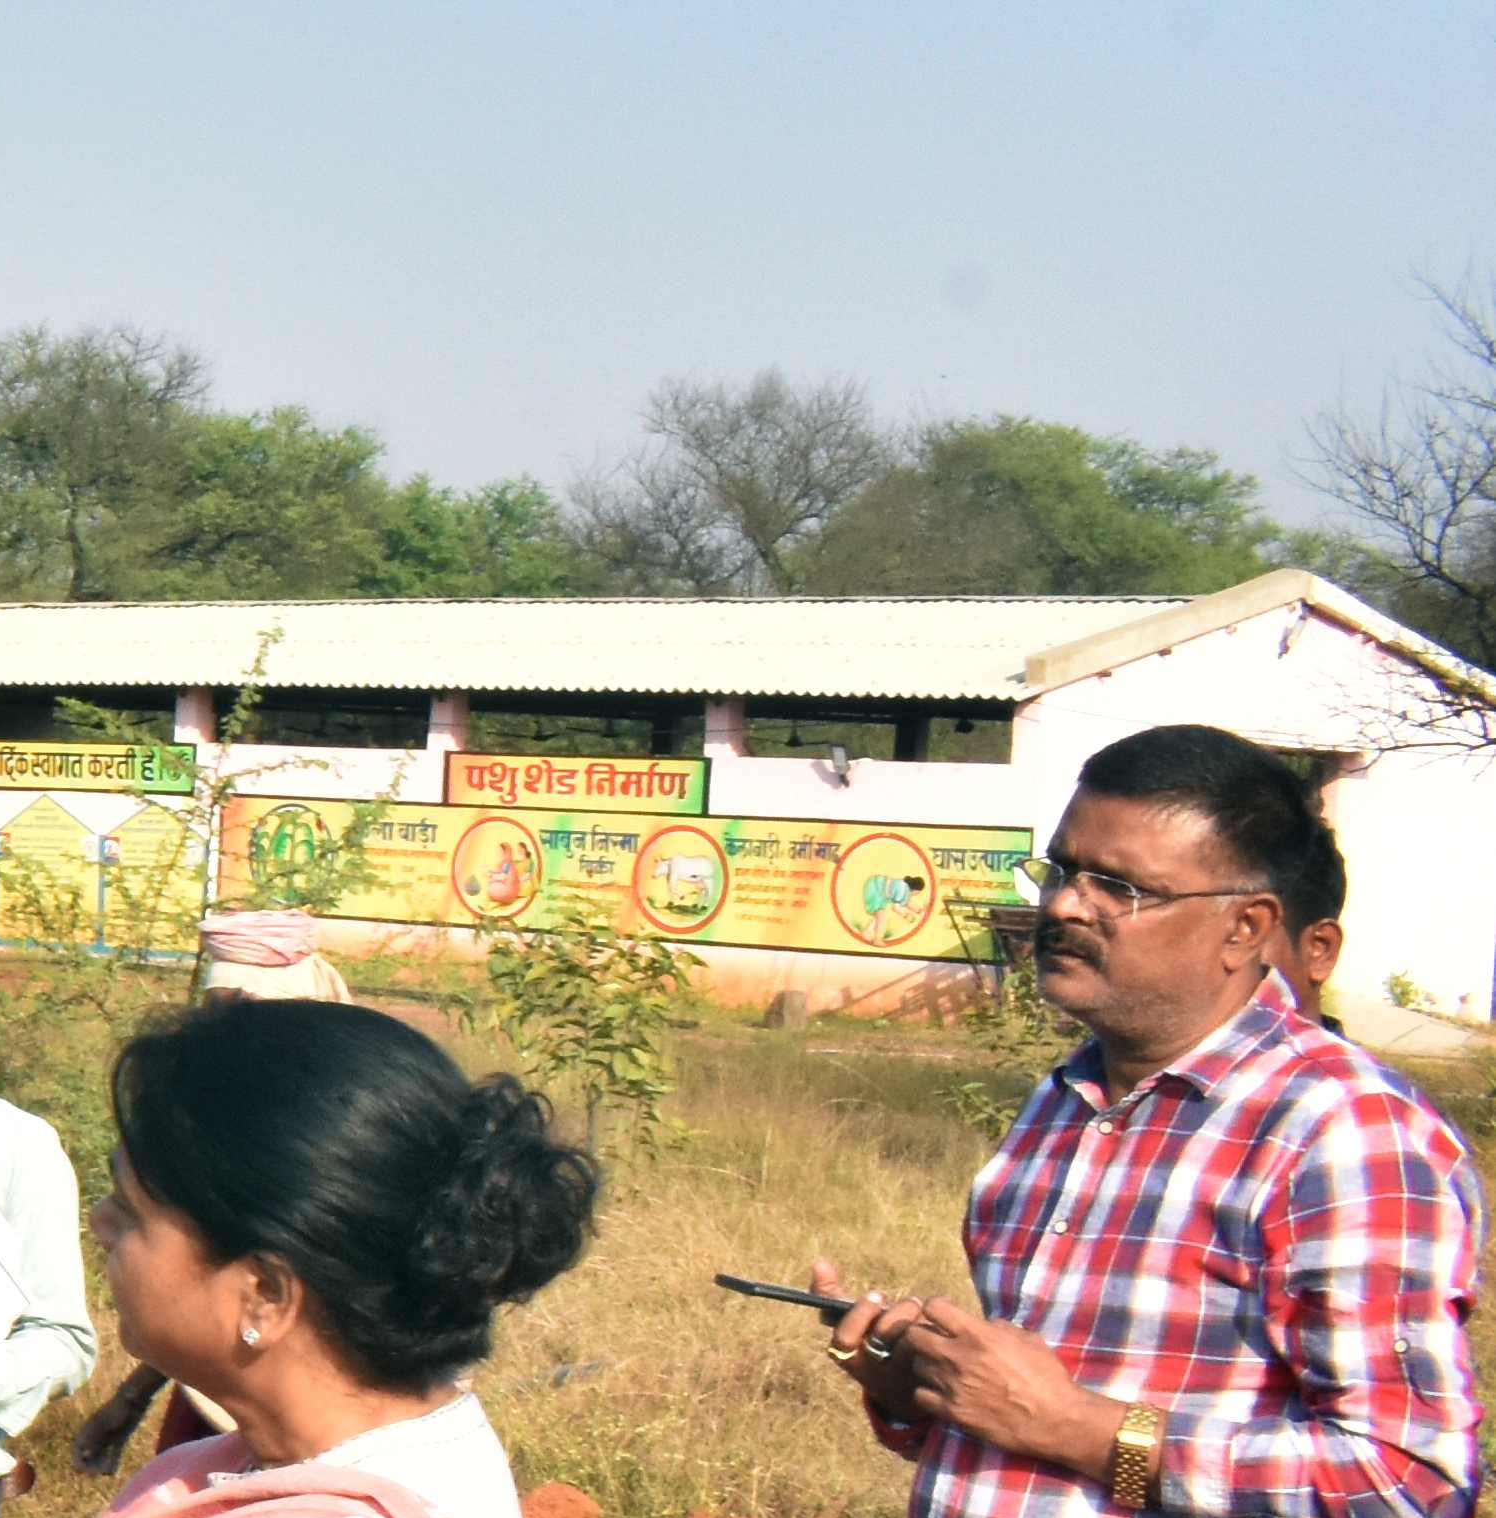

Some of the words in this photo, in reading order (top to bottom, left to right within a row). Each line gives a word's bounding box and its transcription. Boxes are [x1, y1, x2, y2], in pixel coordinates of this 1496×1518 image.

[29, 751, 85, 779] स्वागत
[88, 747, 137, 780] करती
[464, 762, 519, 805] पशु
[523, 760, 579, 796] शेड
[585, 762, 690, 800] निर्माण
